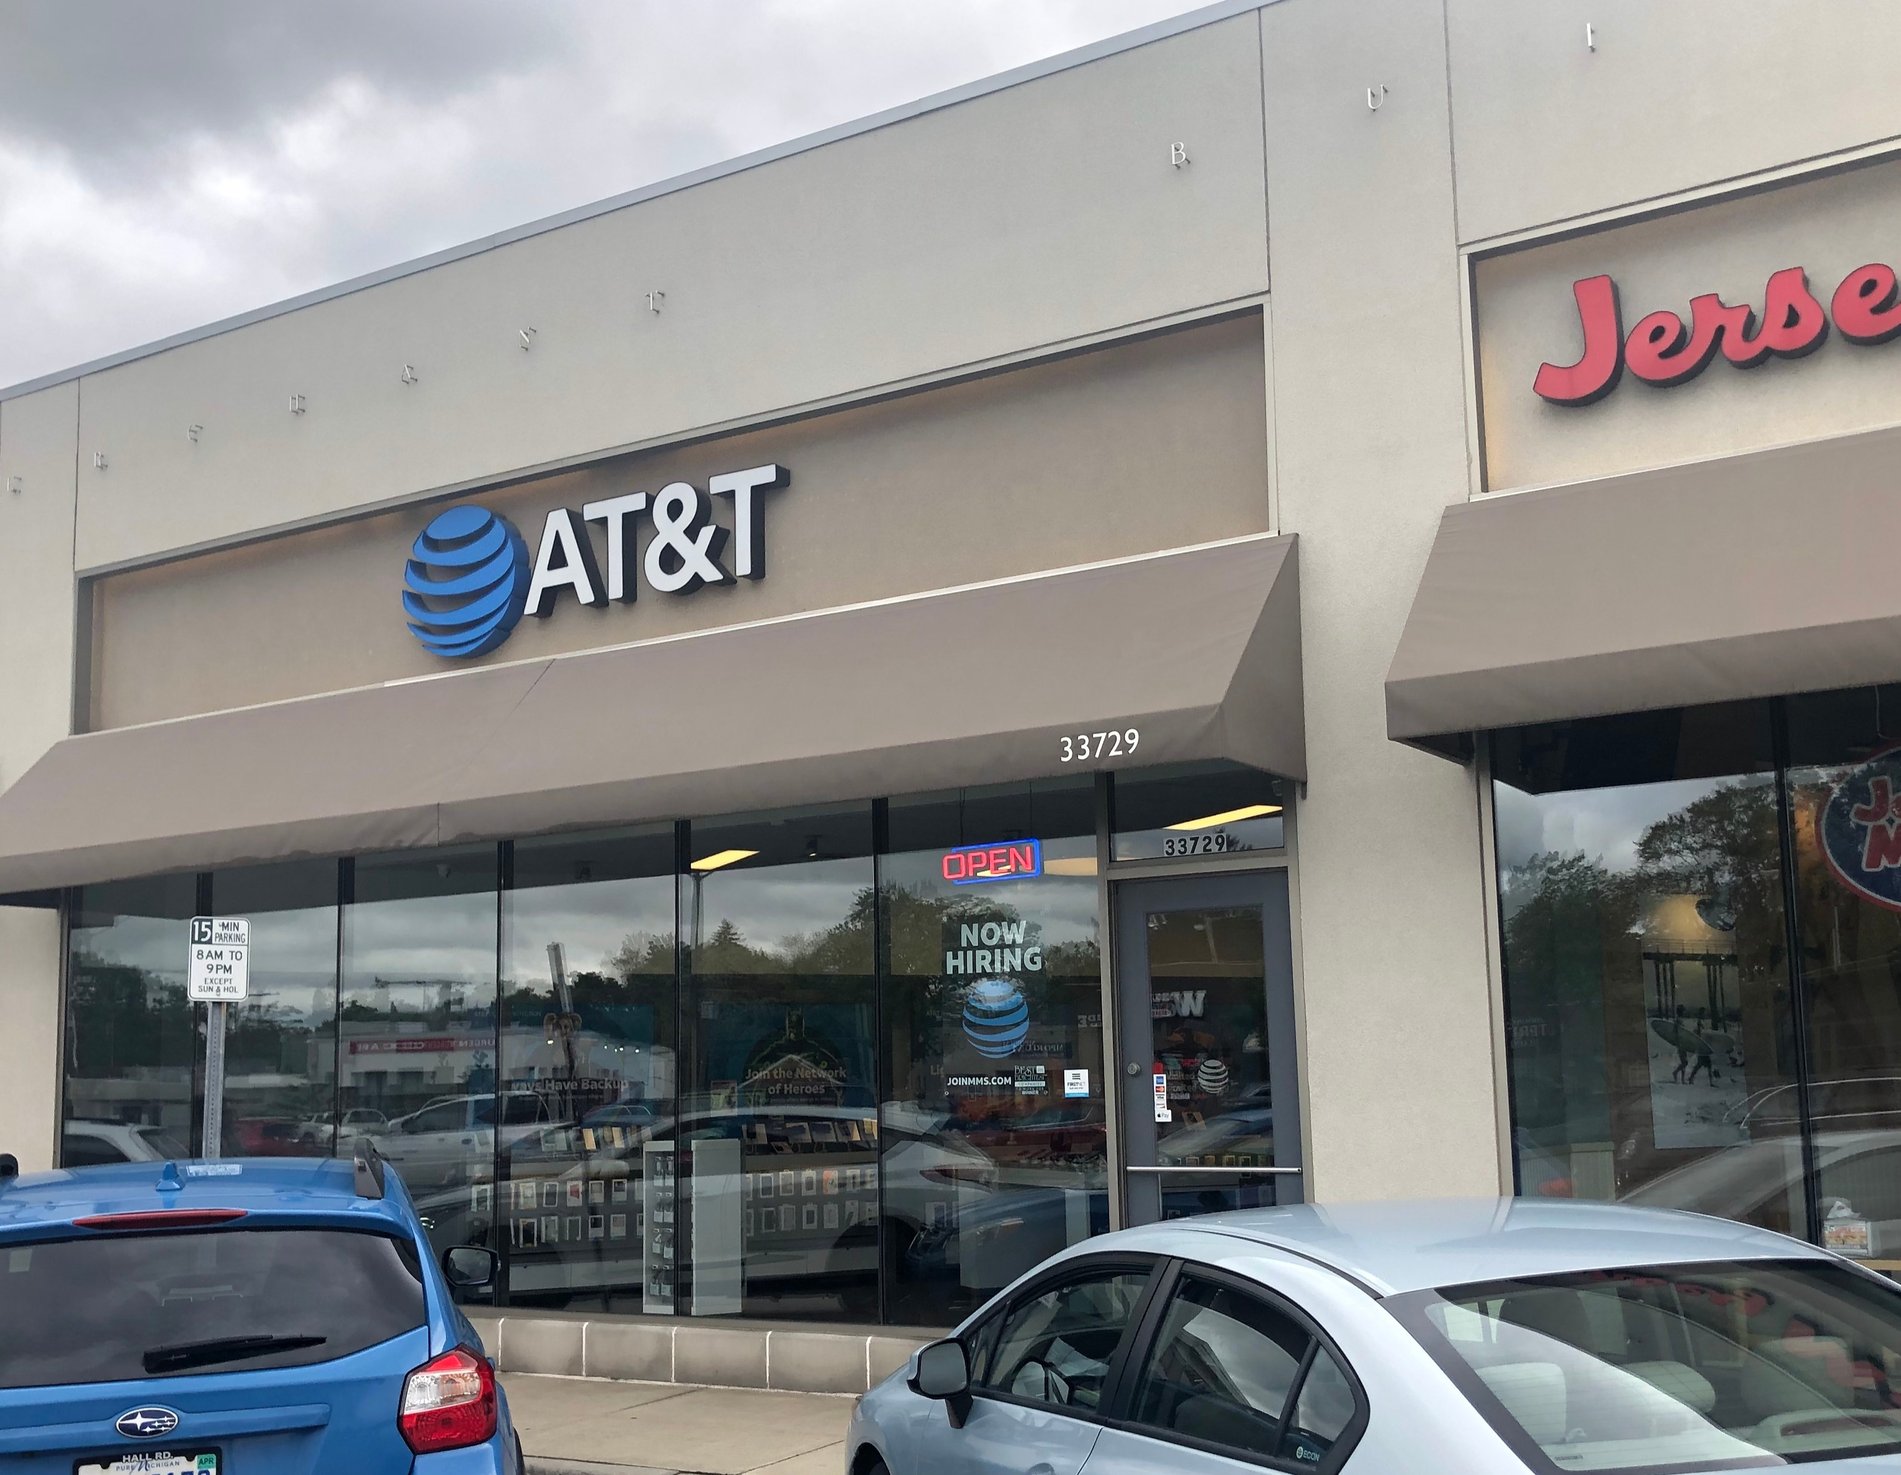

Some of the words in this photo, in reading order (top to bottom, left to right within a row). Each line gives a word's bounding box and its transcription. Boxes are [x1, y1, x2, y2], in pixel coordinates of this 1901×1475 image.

[523, 463, 785, 618] AT&T
[1060, 728, 1140, 762] 33729
[1165, 834, 1226, 856] 33729
[943, 845, 1033, 879] OPEN
[193, 921, 212, 942] 15
[214, 932, 246, 943] PARKING
[960, 920, 1027, 948] NOW
[229, 950, 243, 961] TO
[946, 946, 1042, 975] HIRING
[204, 977, 232, 985] EXCEPT
[198, 985, 214, 993] SUN
[745, 1068, 771, 1080] Join
[773, 1067, 793, 1080] the
[795, 1067, 847, 1080] Network
[545, 1080, 578, 1091] Have
[581, 1077, 629, 1093] Backup
[947, 1076, 1012, 1086] JOINMMS.COM
[768, 1083, 782, 1095] of
[783, 1083, 825, 1095] Heroes
[122, 1453, 151, 1463] HALL
[198, 1457, 215, 1466] APR
[116, 1464, 135, 1472] PURE
